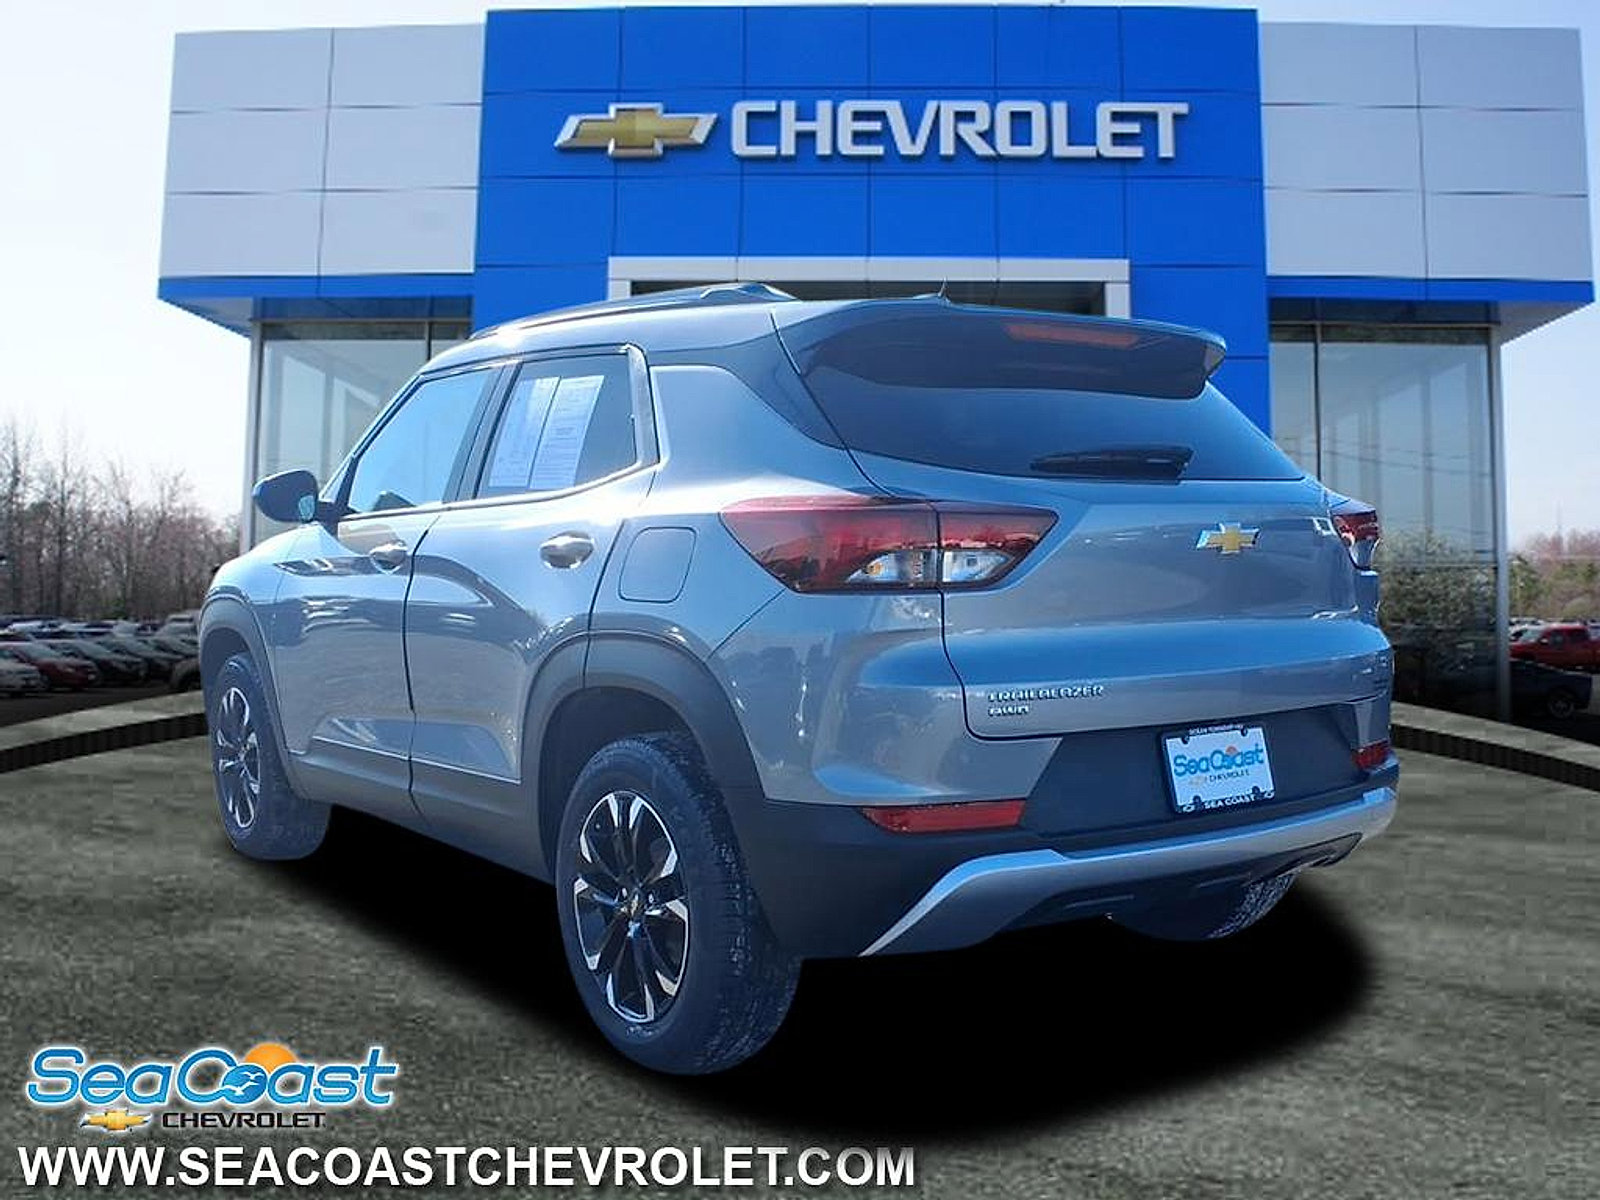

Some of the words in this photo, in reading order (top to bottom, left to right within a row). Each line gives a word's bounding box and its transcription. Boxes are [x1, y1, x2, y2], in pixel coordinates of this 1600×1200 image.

[732, 100, 1189, 158] CHEVROLET
[1204, 800, 1224, 809] SEA
[1225, 795, 1257, 806] COAST
